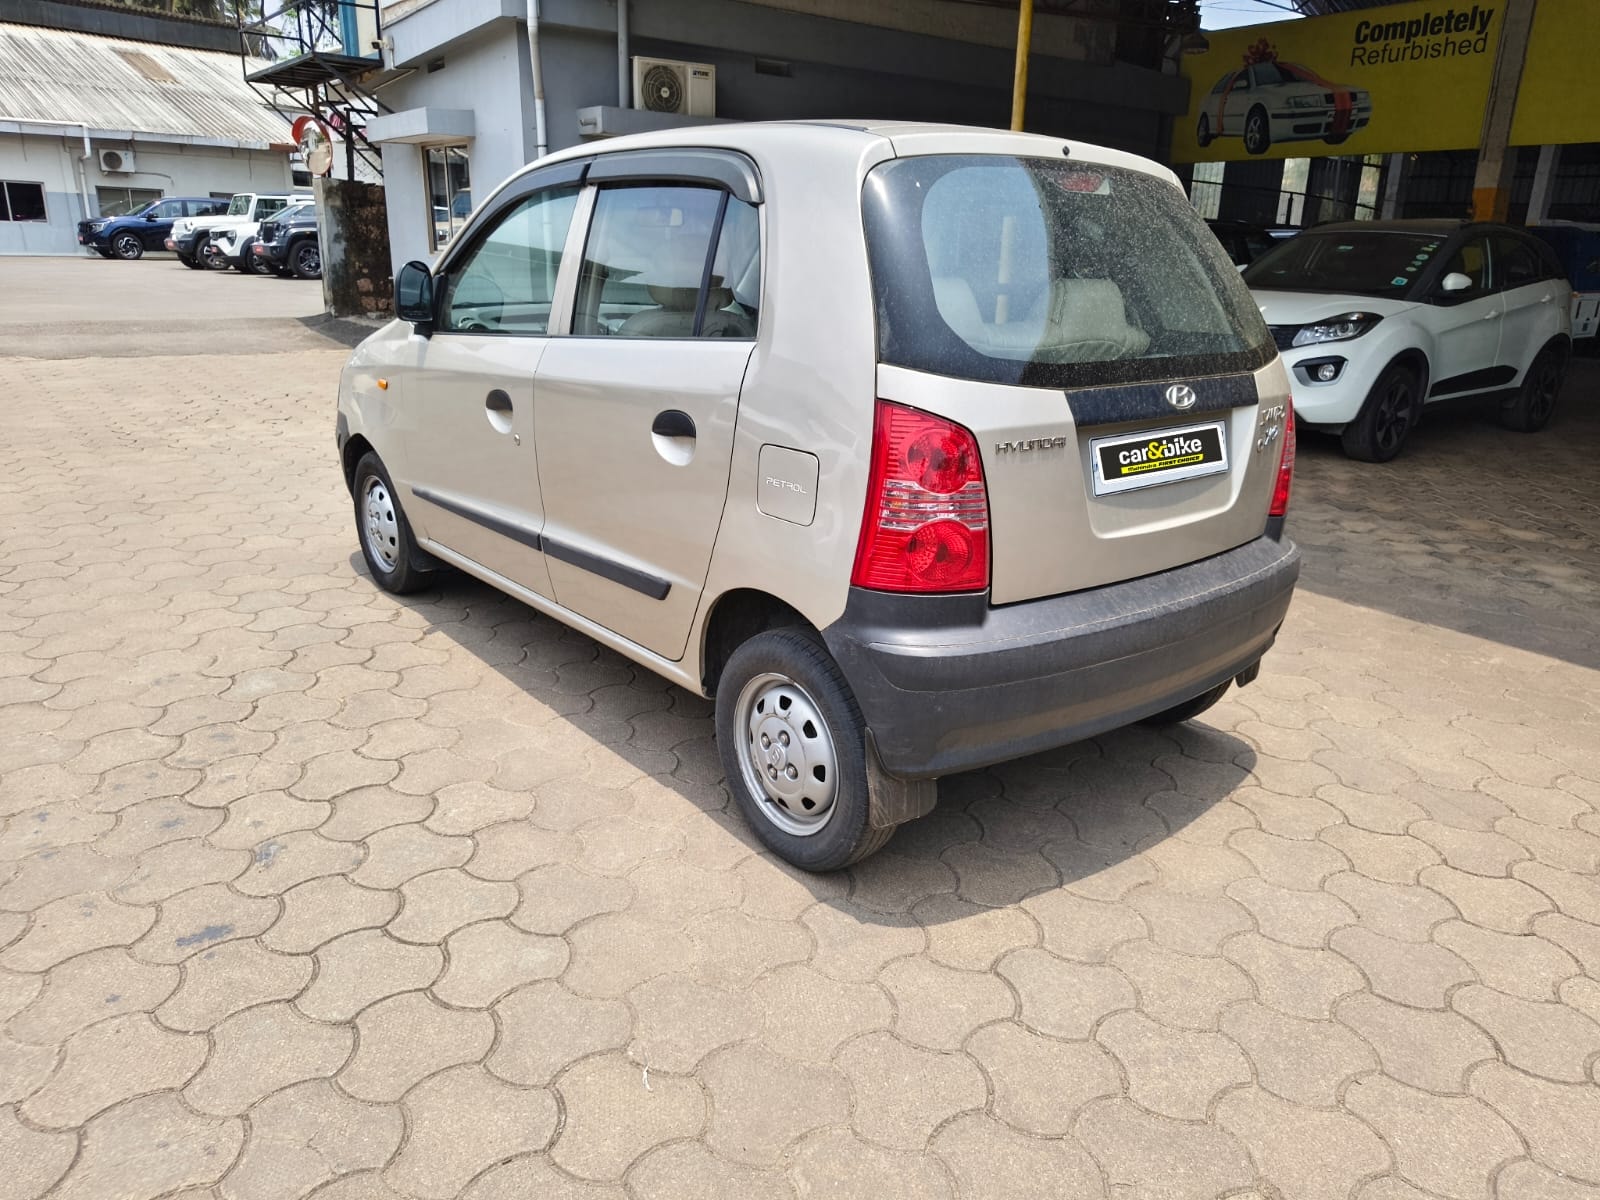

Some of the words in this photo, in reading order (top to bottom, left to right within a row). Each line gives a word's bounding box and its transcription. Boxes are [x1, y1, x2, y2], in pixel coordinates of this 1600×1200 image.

[1355, 5, 1494, 44] Completely
[1350, 32, 1489, 67] Refurbished
[995, 436, 1067, 455] HYUNDAI
[766, 476, 808, 494] PETROL
